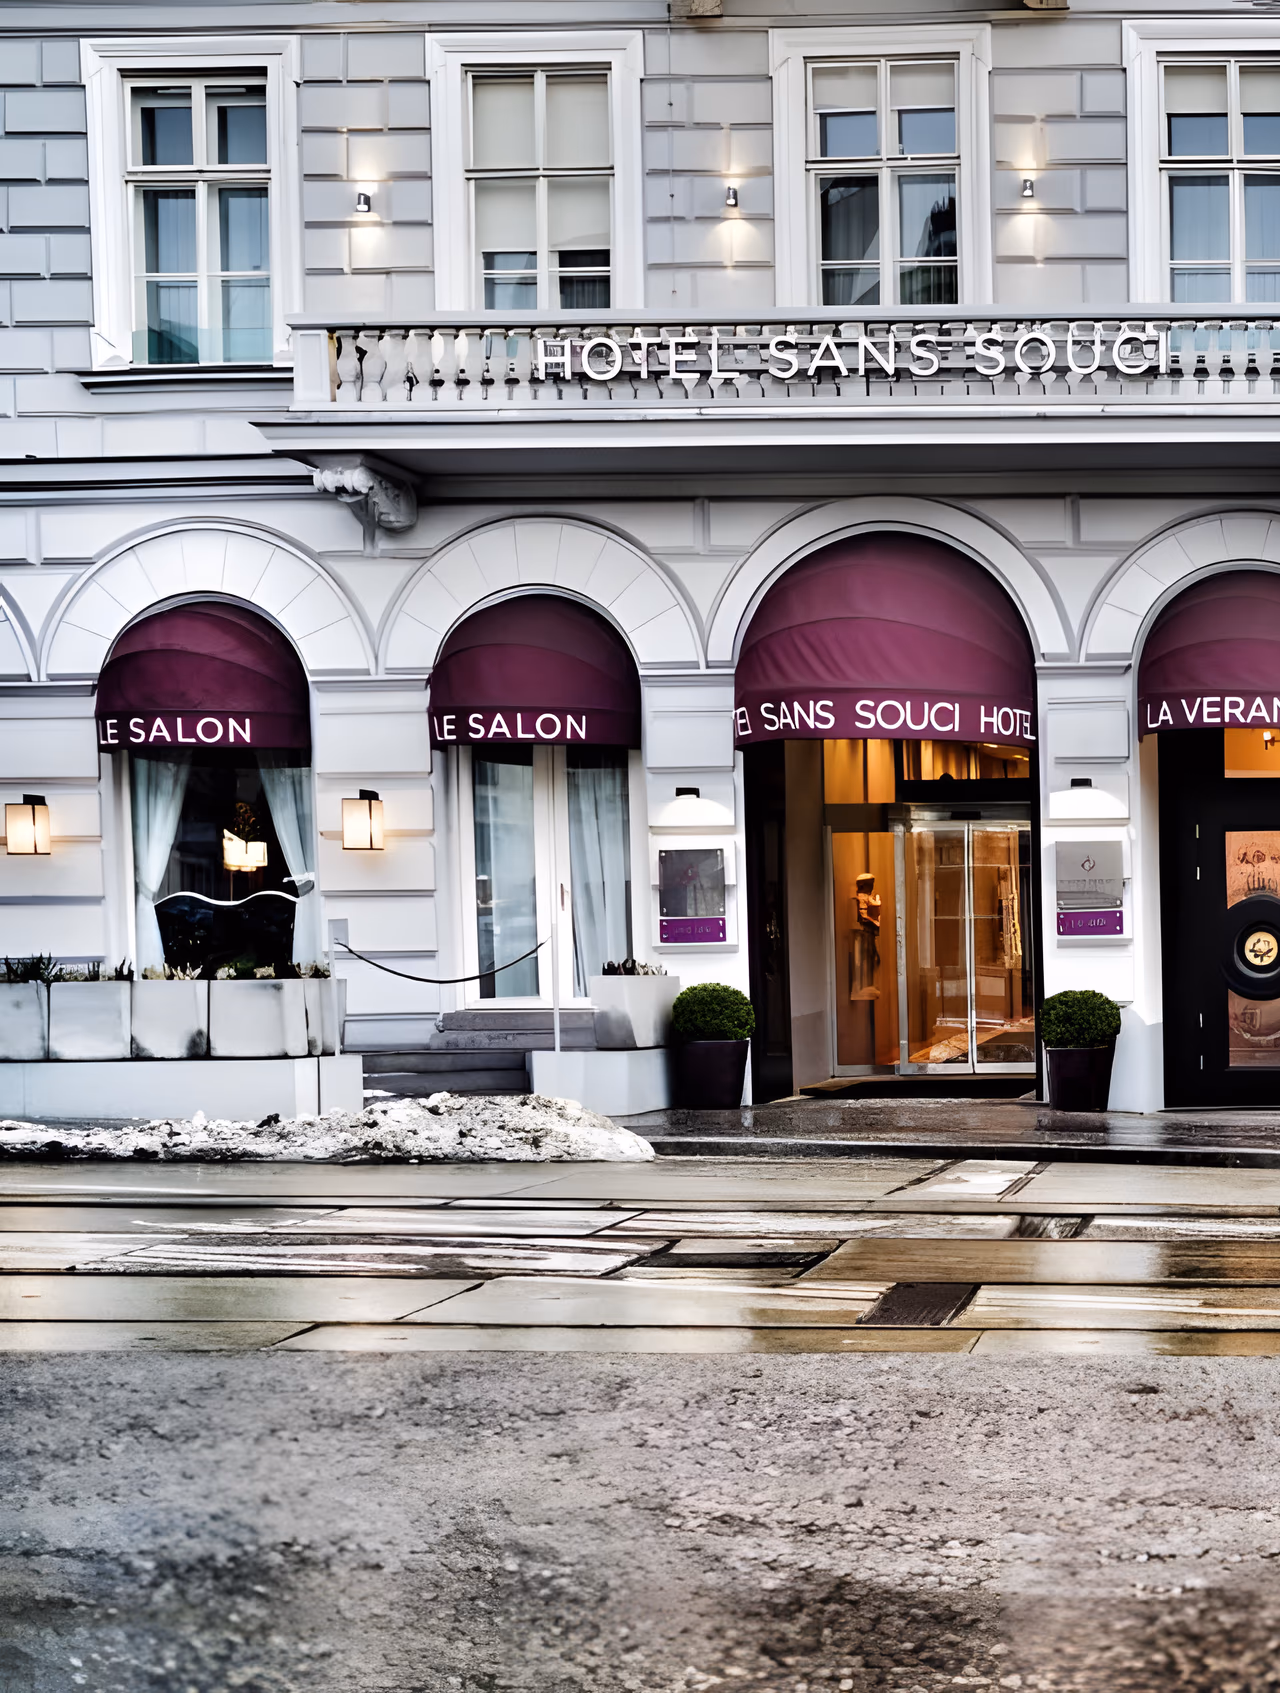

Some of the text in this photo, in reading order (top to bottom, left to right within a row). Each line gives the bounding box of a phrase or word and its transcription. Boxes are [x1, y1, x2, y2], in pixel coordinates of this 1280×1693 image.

[537, 330, 1168, 382] HOTEL SANS SOUCI
[433, 712, 586, 741] LE SALON
[760, 699, 836, 731] SANS
[854, 699, 960, 733] SOUCI
[980, 704, 1037, 741] HOTEL
[1147, 700, 1173, 727] LA
[99, 717, 251, 744] LE SALON
